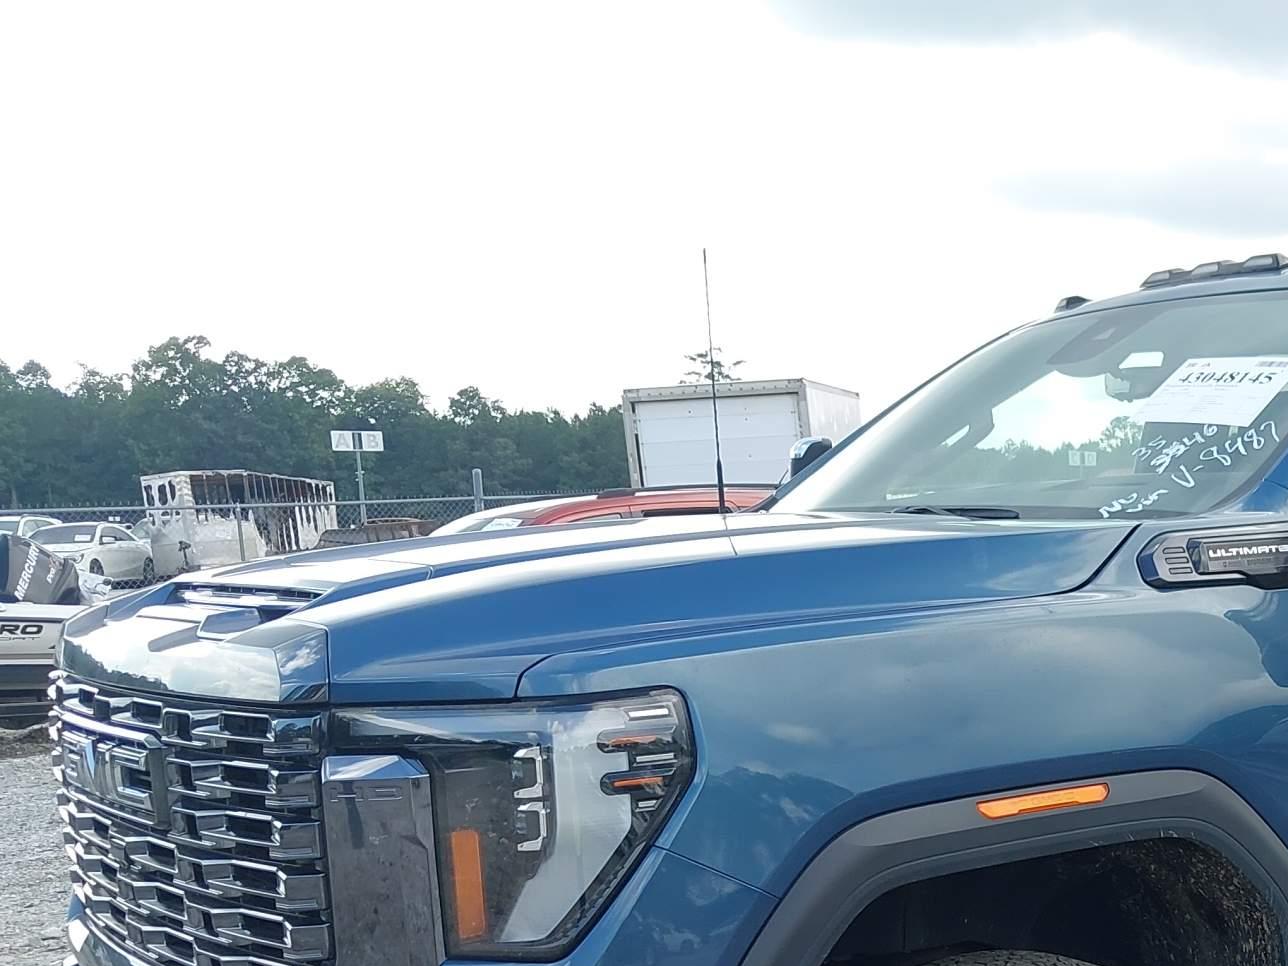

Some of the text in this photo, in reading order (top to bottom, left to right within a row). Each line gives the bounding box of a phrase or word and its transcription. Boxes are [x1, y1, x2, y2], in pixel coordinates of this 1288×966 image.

[1178, 371, 1279, 385] 43048145
[335, 433, 350, 449] A
[366, 433, 379, 449] B
